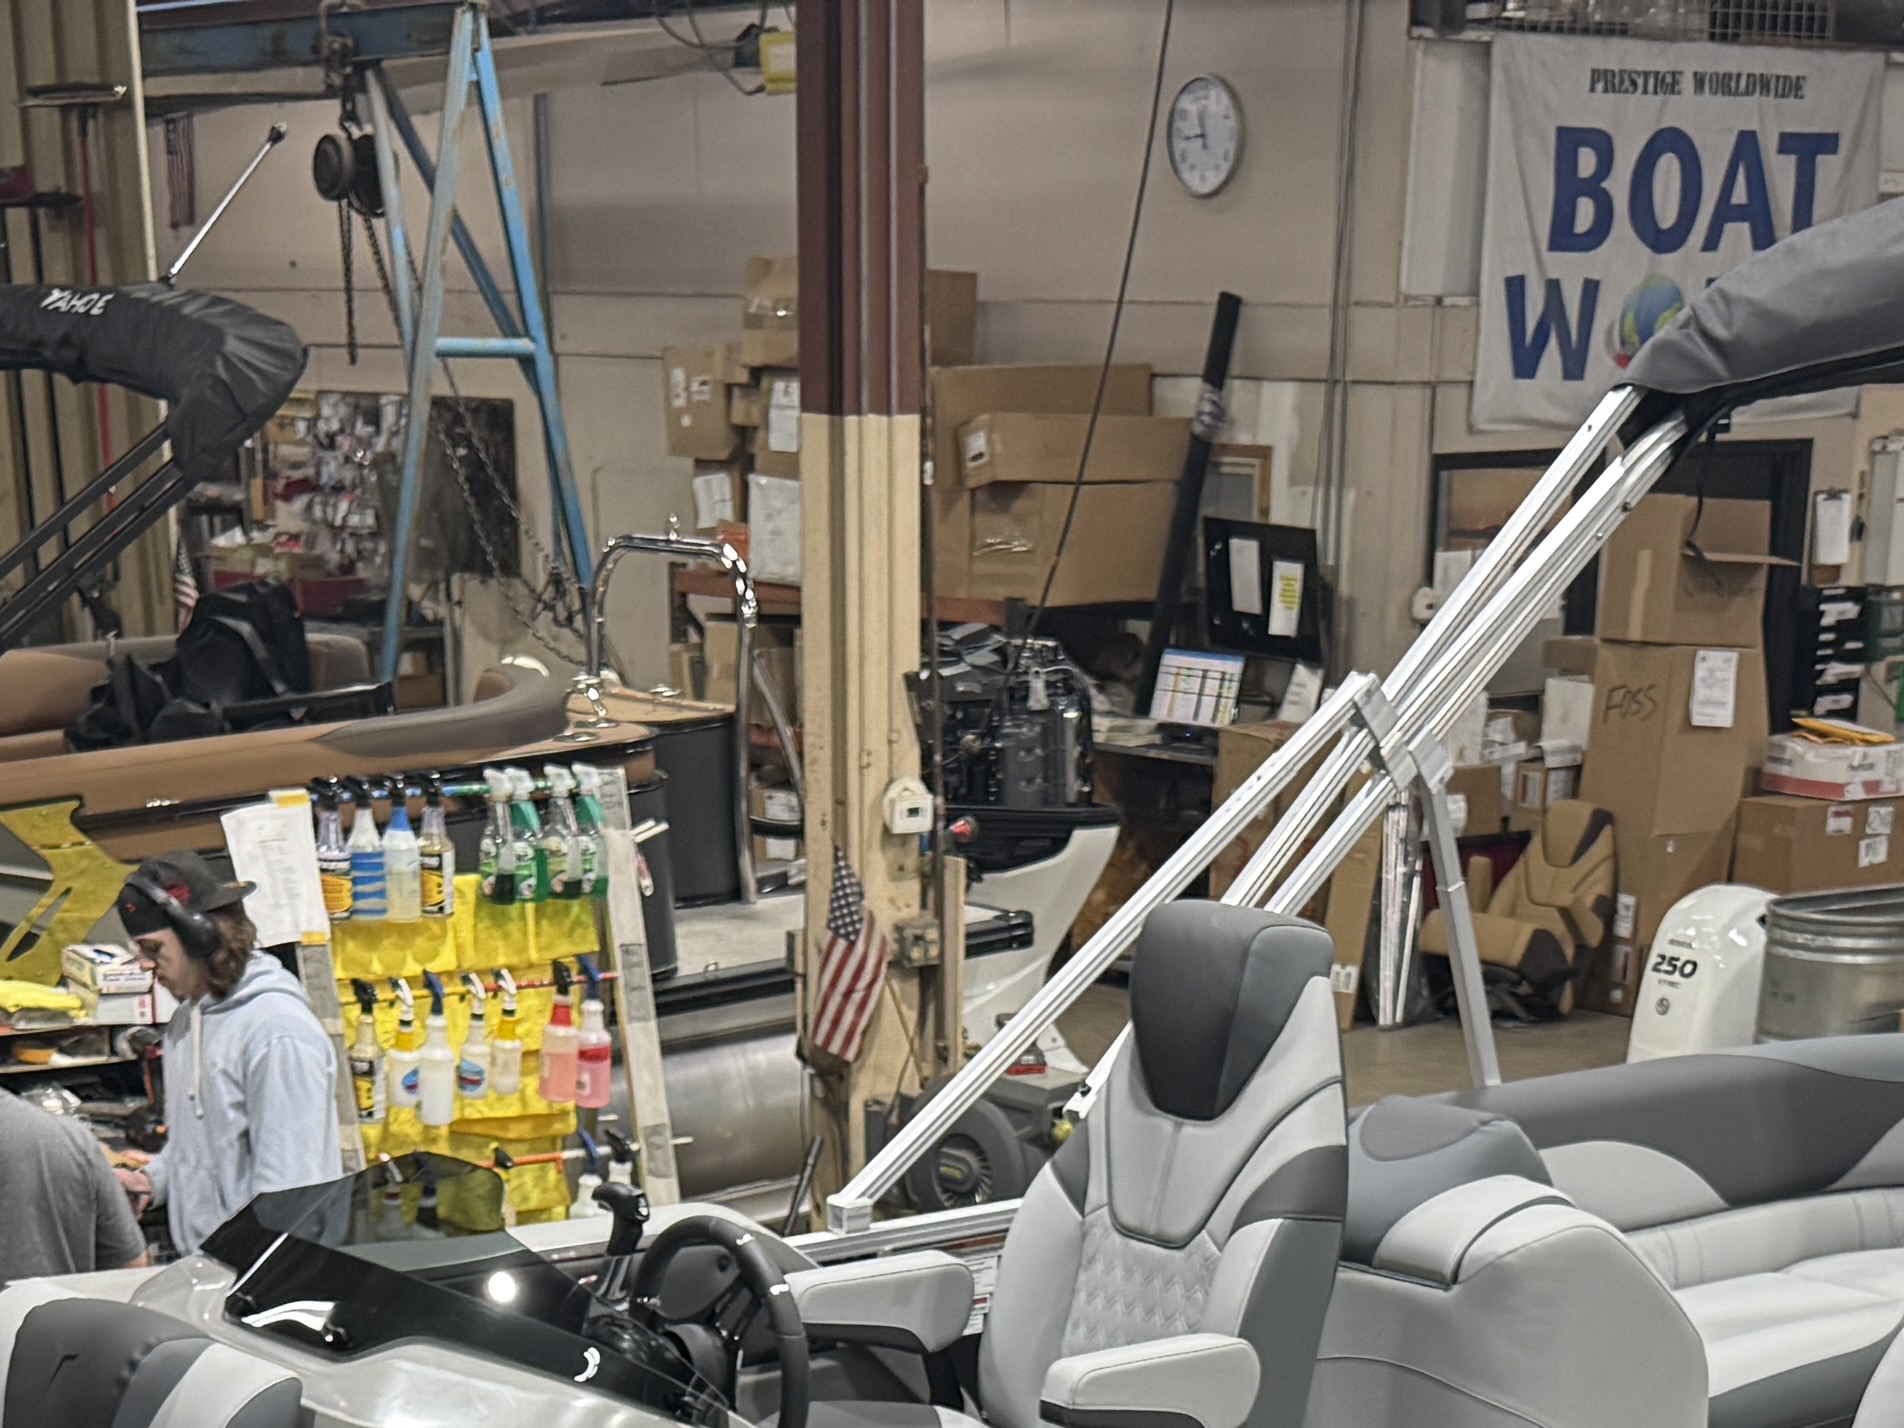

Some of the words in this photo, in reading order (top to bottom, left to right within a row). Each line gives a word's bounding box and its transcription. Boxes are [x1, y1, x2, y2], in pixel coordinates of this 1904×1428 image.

[1589, 68, 1683, 96] PRESTIGE
[1693, 71, 1806, 100] WORLDWIDE
[1548, 125, 1840, 255] BOAT
[1651, 953, 1698, 980] 250
